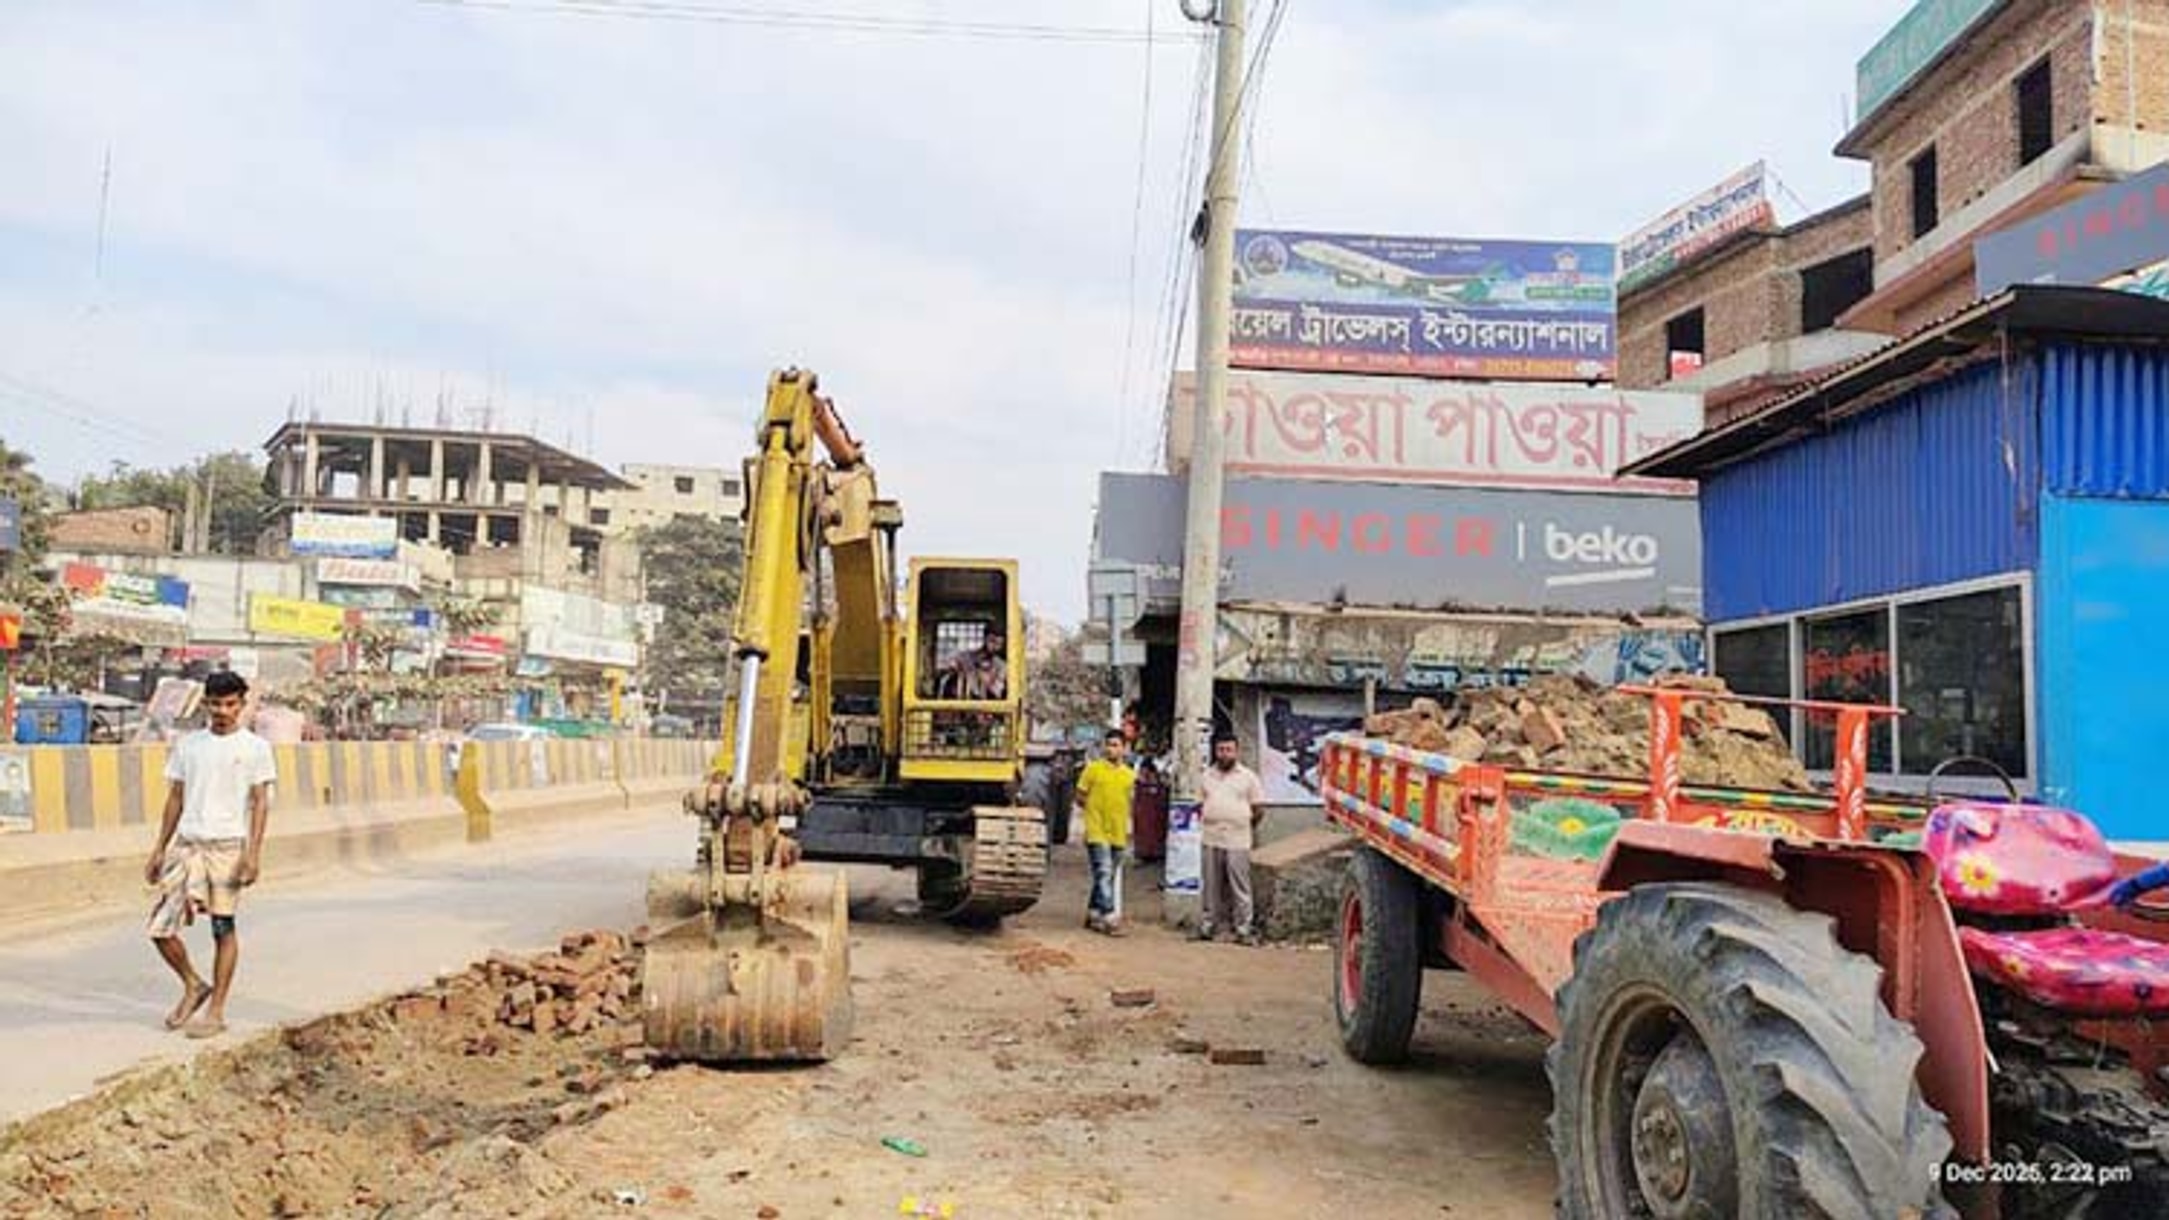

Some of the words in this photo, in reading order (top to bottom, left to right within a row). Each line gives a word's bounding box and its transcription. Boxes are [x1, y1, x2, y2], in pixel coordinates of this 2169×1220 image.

[1421, 309, 1608, 350] ইন্টারন্যাশনাল
[1426, 394, 1637, 470] পাওয়া
[1220, 504, 1492, 558] SINGER
[1546, 522, 1658, 564] beko
